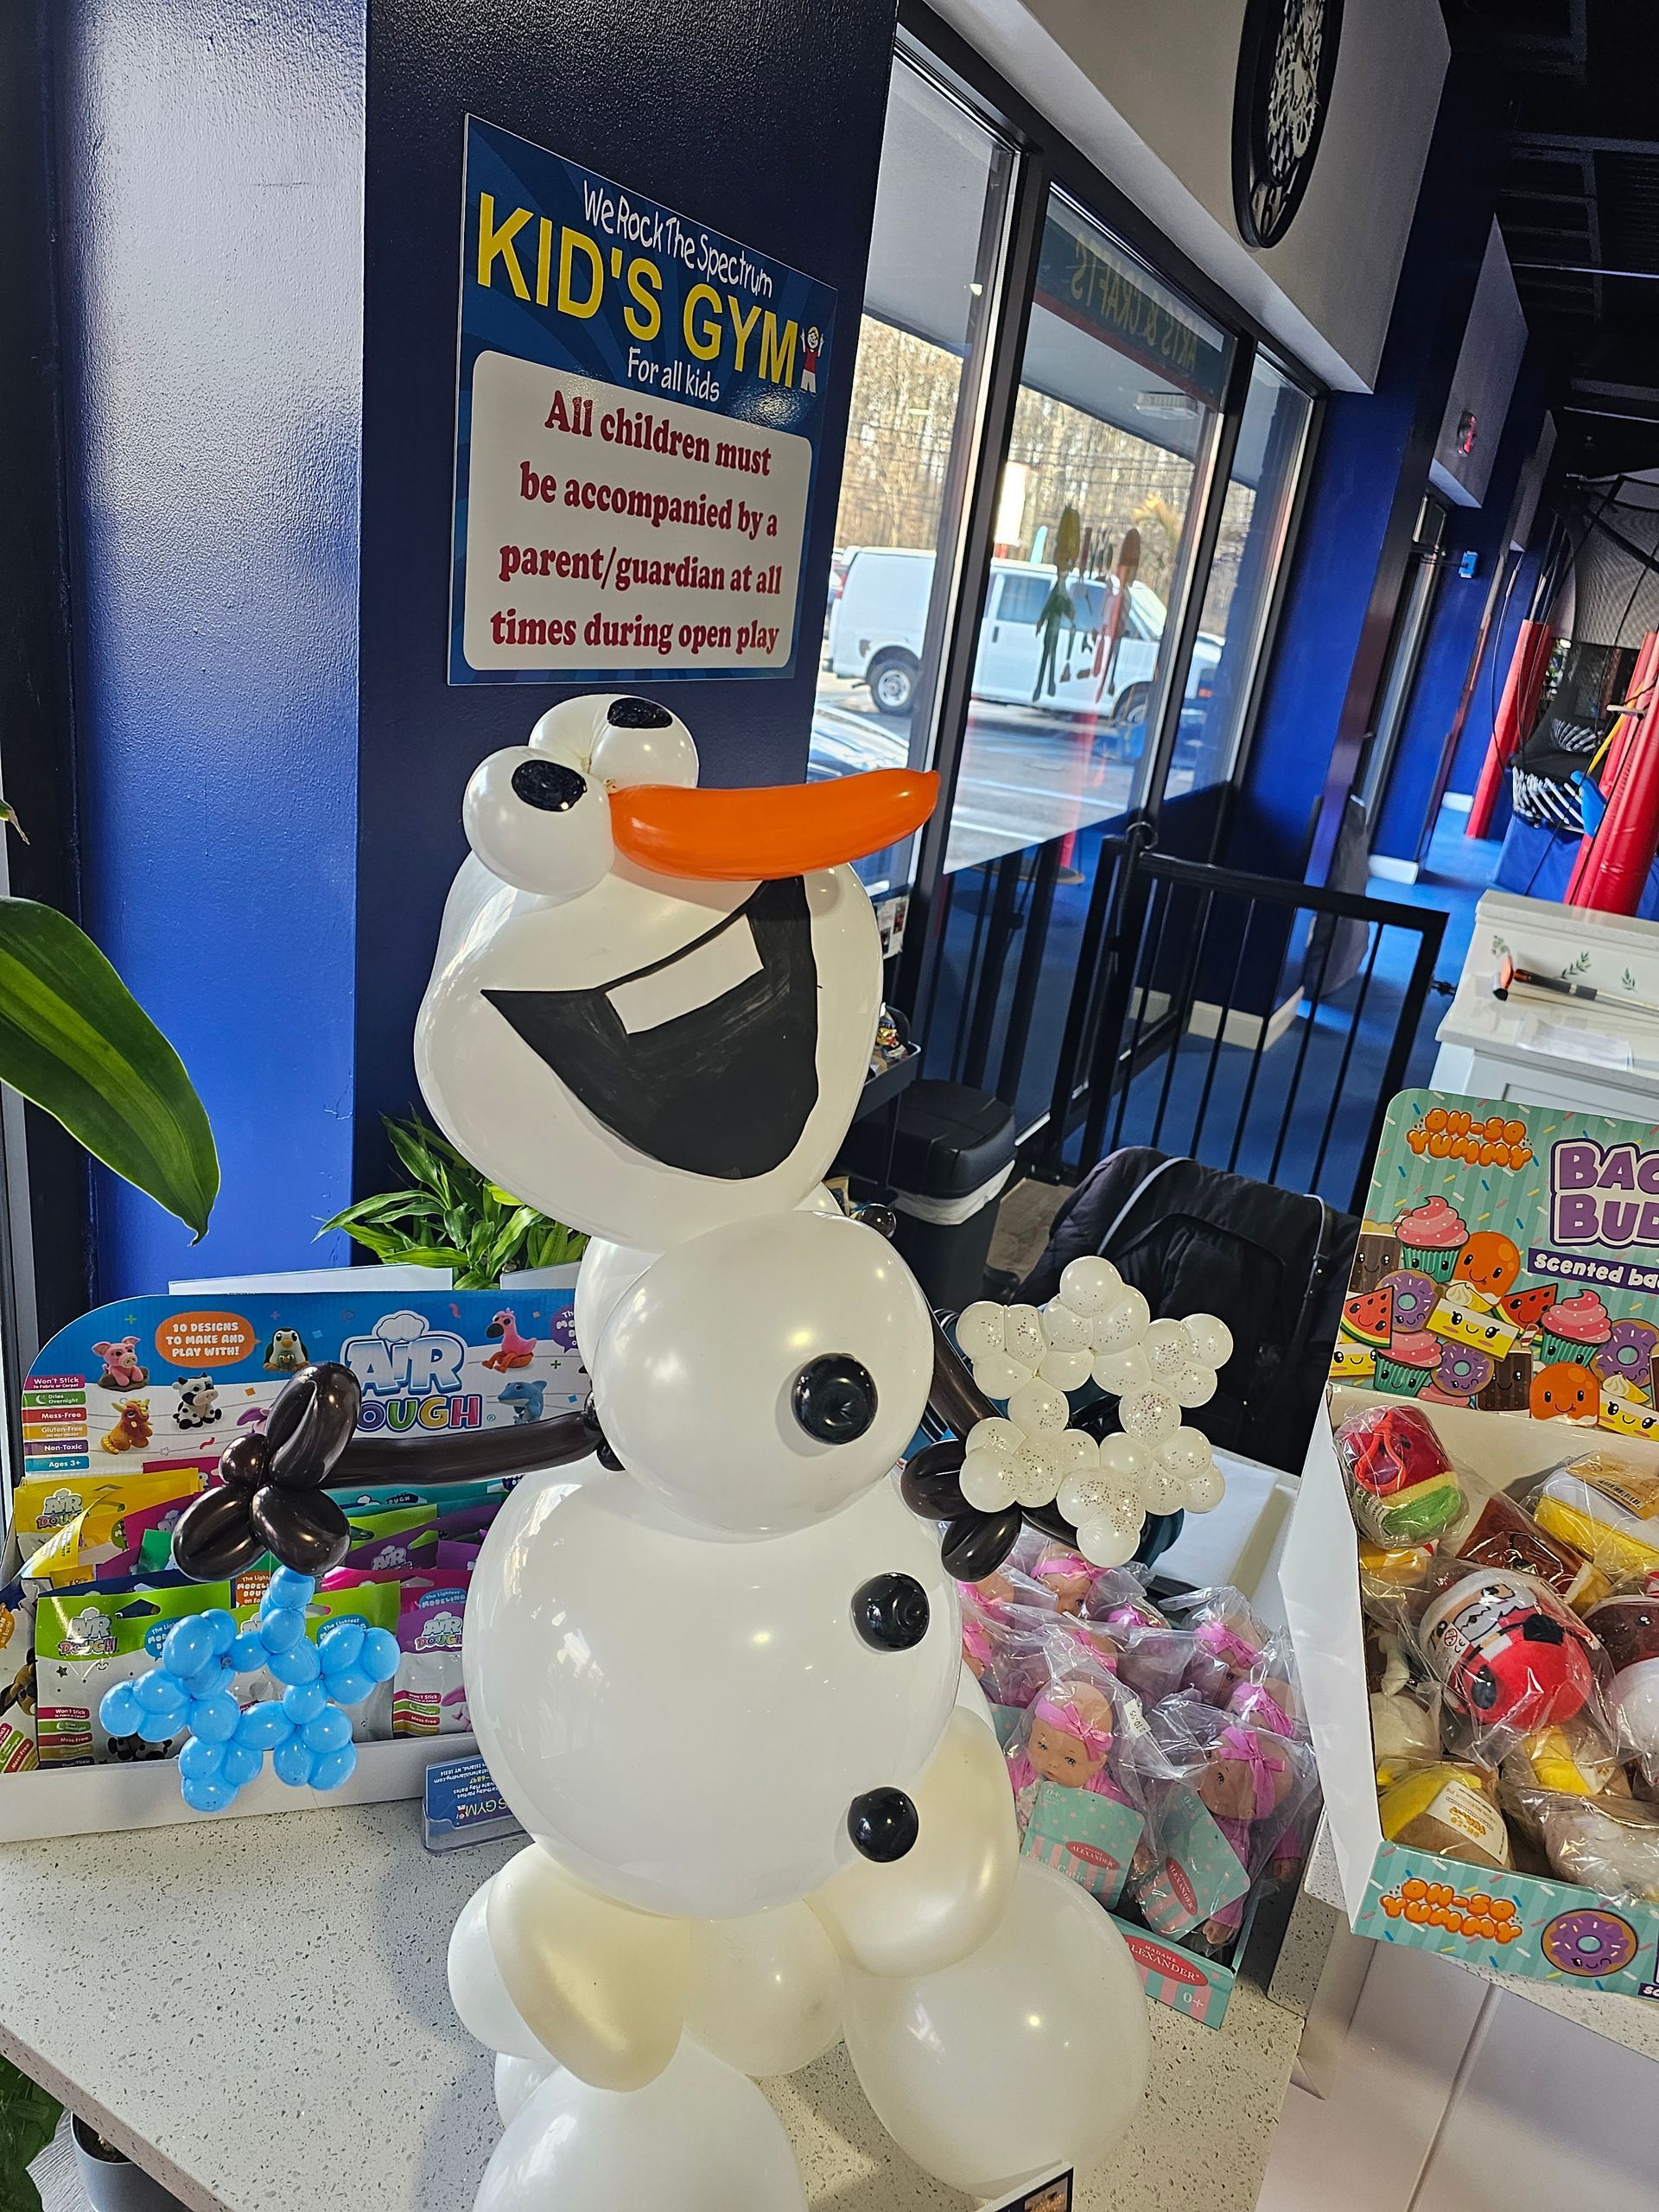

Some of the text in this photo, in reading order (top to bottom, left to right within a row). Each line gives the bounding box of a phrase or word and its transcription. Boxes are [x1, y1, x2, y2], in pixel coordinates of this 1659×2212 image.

[583, 179, 772, 298] We Rock The Spectrum
[477, 192, 798, 388] KID'S GYM
[627, 346, 720, 403] For all kids
[543, 390, 772, 476] All children must
[519, 461, 778, 540] be accompanied by a
[499, 545, 782, 594] parent/guardian at all
[491, 608, 779, 655] times during open play
[1406, 1128, 1533, 1171] YUMMY
[1535, 1254, 1624, 1284] scented
[173, 1322, 238, 1332] 10 DESIGNS
[562, 1310, 574, 1319] Th
[166, 1334, 245, 1344] TO MAKE AND
[172, 1346, 239, 1357] PLAY WITH!
[356, 1395, 484, 1431] OUGH
[44, 1443, 83, 1452] Non-Toxic
[436, 1590, 461, 1599] Lightest
[151, 1626, 162, 1635] The
[323, 1622, 335, 1631] The
[465, 1799, 497, 1817] GYM
[1071, 1845, 1115, 1867] ALEXANDER
[1168, 1864, 1195, 1910] ALEXANDER
[1380, 1895, 1522, 1944] YUMMY
[1127, 1942, 1197, 1981] LEXANDER
[1145, 1944, 1177, 1963] MADAME
[1183, 1992, 1204, 2007] 0+
